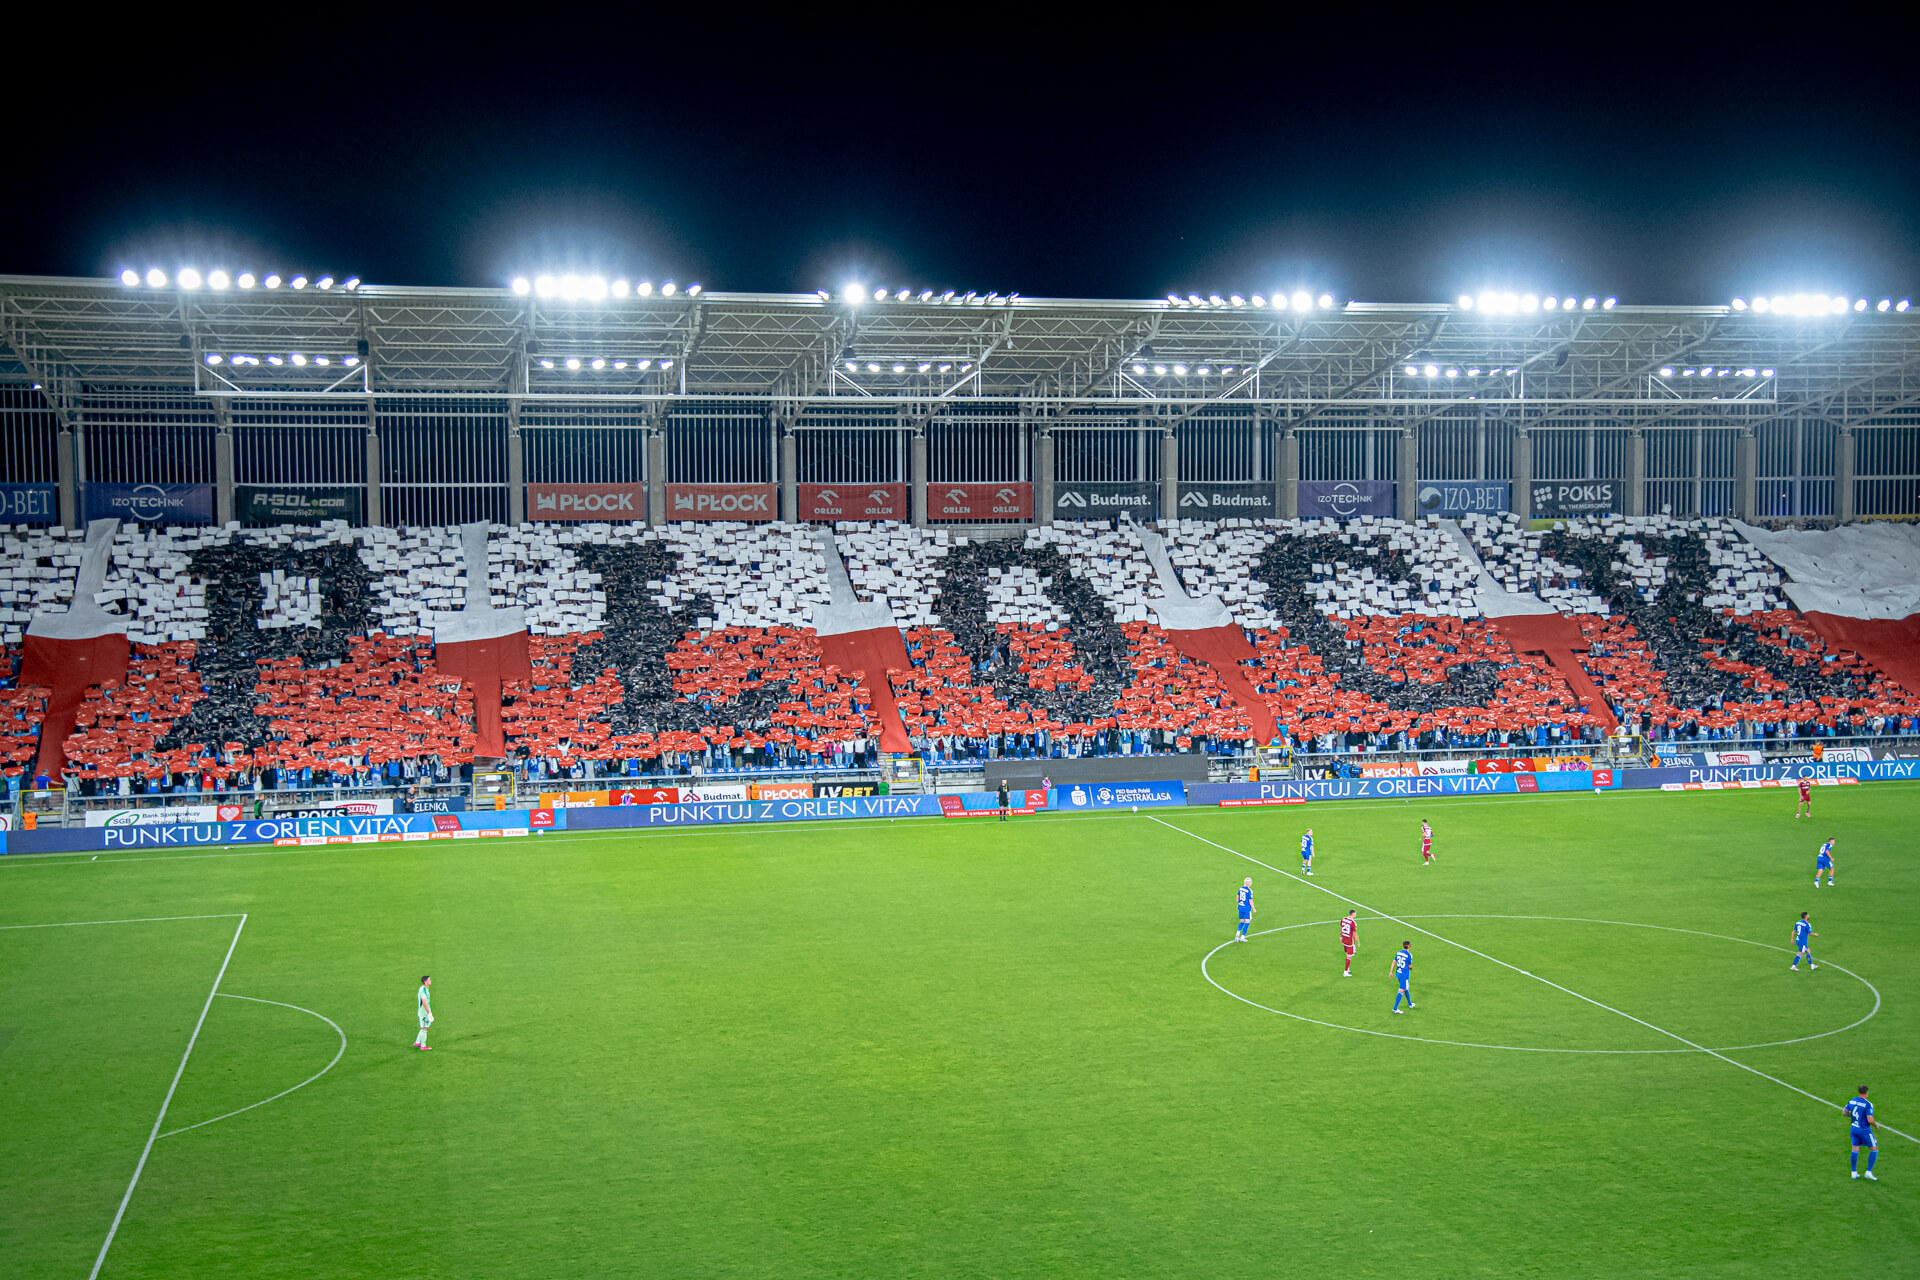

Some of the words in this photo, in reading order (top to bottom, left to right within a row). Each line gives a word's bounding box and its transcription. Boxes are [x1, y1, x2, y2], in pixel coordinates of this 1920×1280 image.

[1090, 493, 1151, 506] Budmat.
[1317, 494, 1373, 504] IZOTECHNIK
[1443, 486, 1504, 511] IZO-BET
[1558, 484, 1612, 502] POKIS
[112, 497, 184, 508] IZOTECHNIK
[559, 493, 634, 511] PŁOCK
[697, 494, 768, 511] PŁOCK
[1212, 493, 1272, 507] Budmat.
[813, 507, 842, 515] ORLEN
[865, 507, 893, 515] ORLEN
[942, 506, 971, 514] ORLEN
[992, 505, 1020, 513] ORLEN
[1720, 755, 1750, 764] KASZTELAN
[1374, 767, 1414, 777] PŁOCK
[1689, 766, 1774, 783] PUNKTUJ
[1781, 766, 1792, 779] Z
[1798, 764, 1861, 779] ORLEN
[1867, 762, 1916, 777] VITAY
[1261, 780, 1351, 799] PUNKTUJ
[1357, 781, 1369, 795] Z
[1377, 776, 1443, 795] ORLEN
[1449, 775, 1501, 792] VITAY
[764, 789, 809, 800] PŁOCK
[1116, 792, 1172, 803] EKSTRAKLASA
[347, 805, 376, 814] SZTELAN
[414, 802, 449, 813] ELENKA
[650, 803, 751, 823] PUNKTUJ
[760, 803, 774, 818] Z
[782, 800, 856, 817] ORLEN
[863, 797, 921, 815] VITAY
[104, 824, 222, 846] PUNKTUJ
[231, 823, 247, 840] Z
[256, 819, 340, 839] ORLEN
[349, 816, 414, 834] VITAY
[1341, 922, 1351, 934] 29
[1396, 956, 1406, 969] 35
[1852, 1106, 1859, 1120] 4
